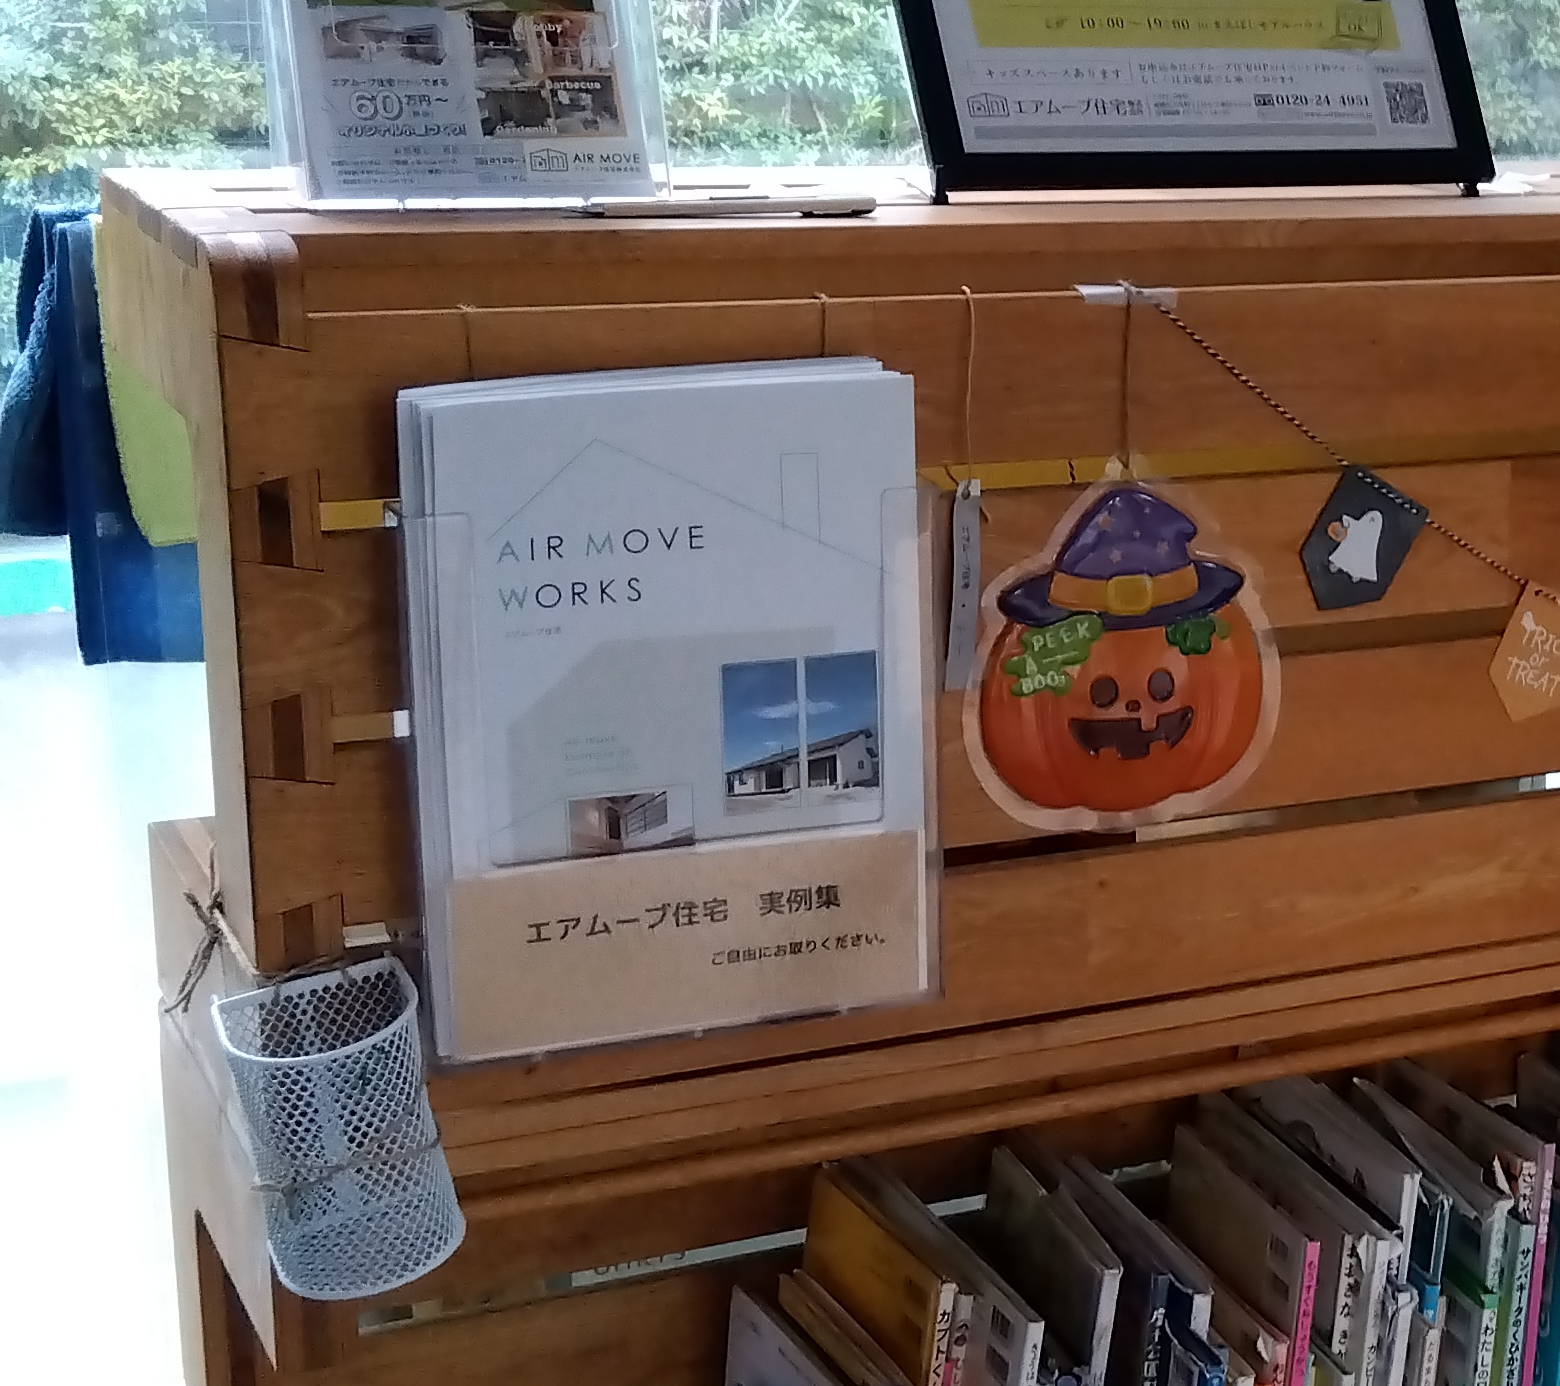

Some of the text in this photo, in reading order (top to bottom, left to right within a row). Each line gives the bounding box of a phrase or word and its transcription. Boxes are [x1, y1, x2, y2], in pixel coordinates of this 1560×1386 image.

[573, 153, 641, 164] AIR MOVE
[496, 525, 705, 563] AIR MOVE
[498, 577, 643, 611] WORKS
[1032, 620, 1092, 652] PEEK
[1529, 652, 1550, 668] or
[526, 884, 842, 944] エアムーブ住宅 実例集
[711, 932, 887, 966] ご自由にお取りください。
